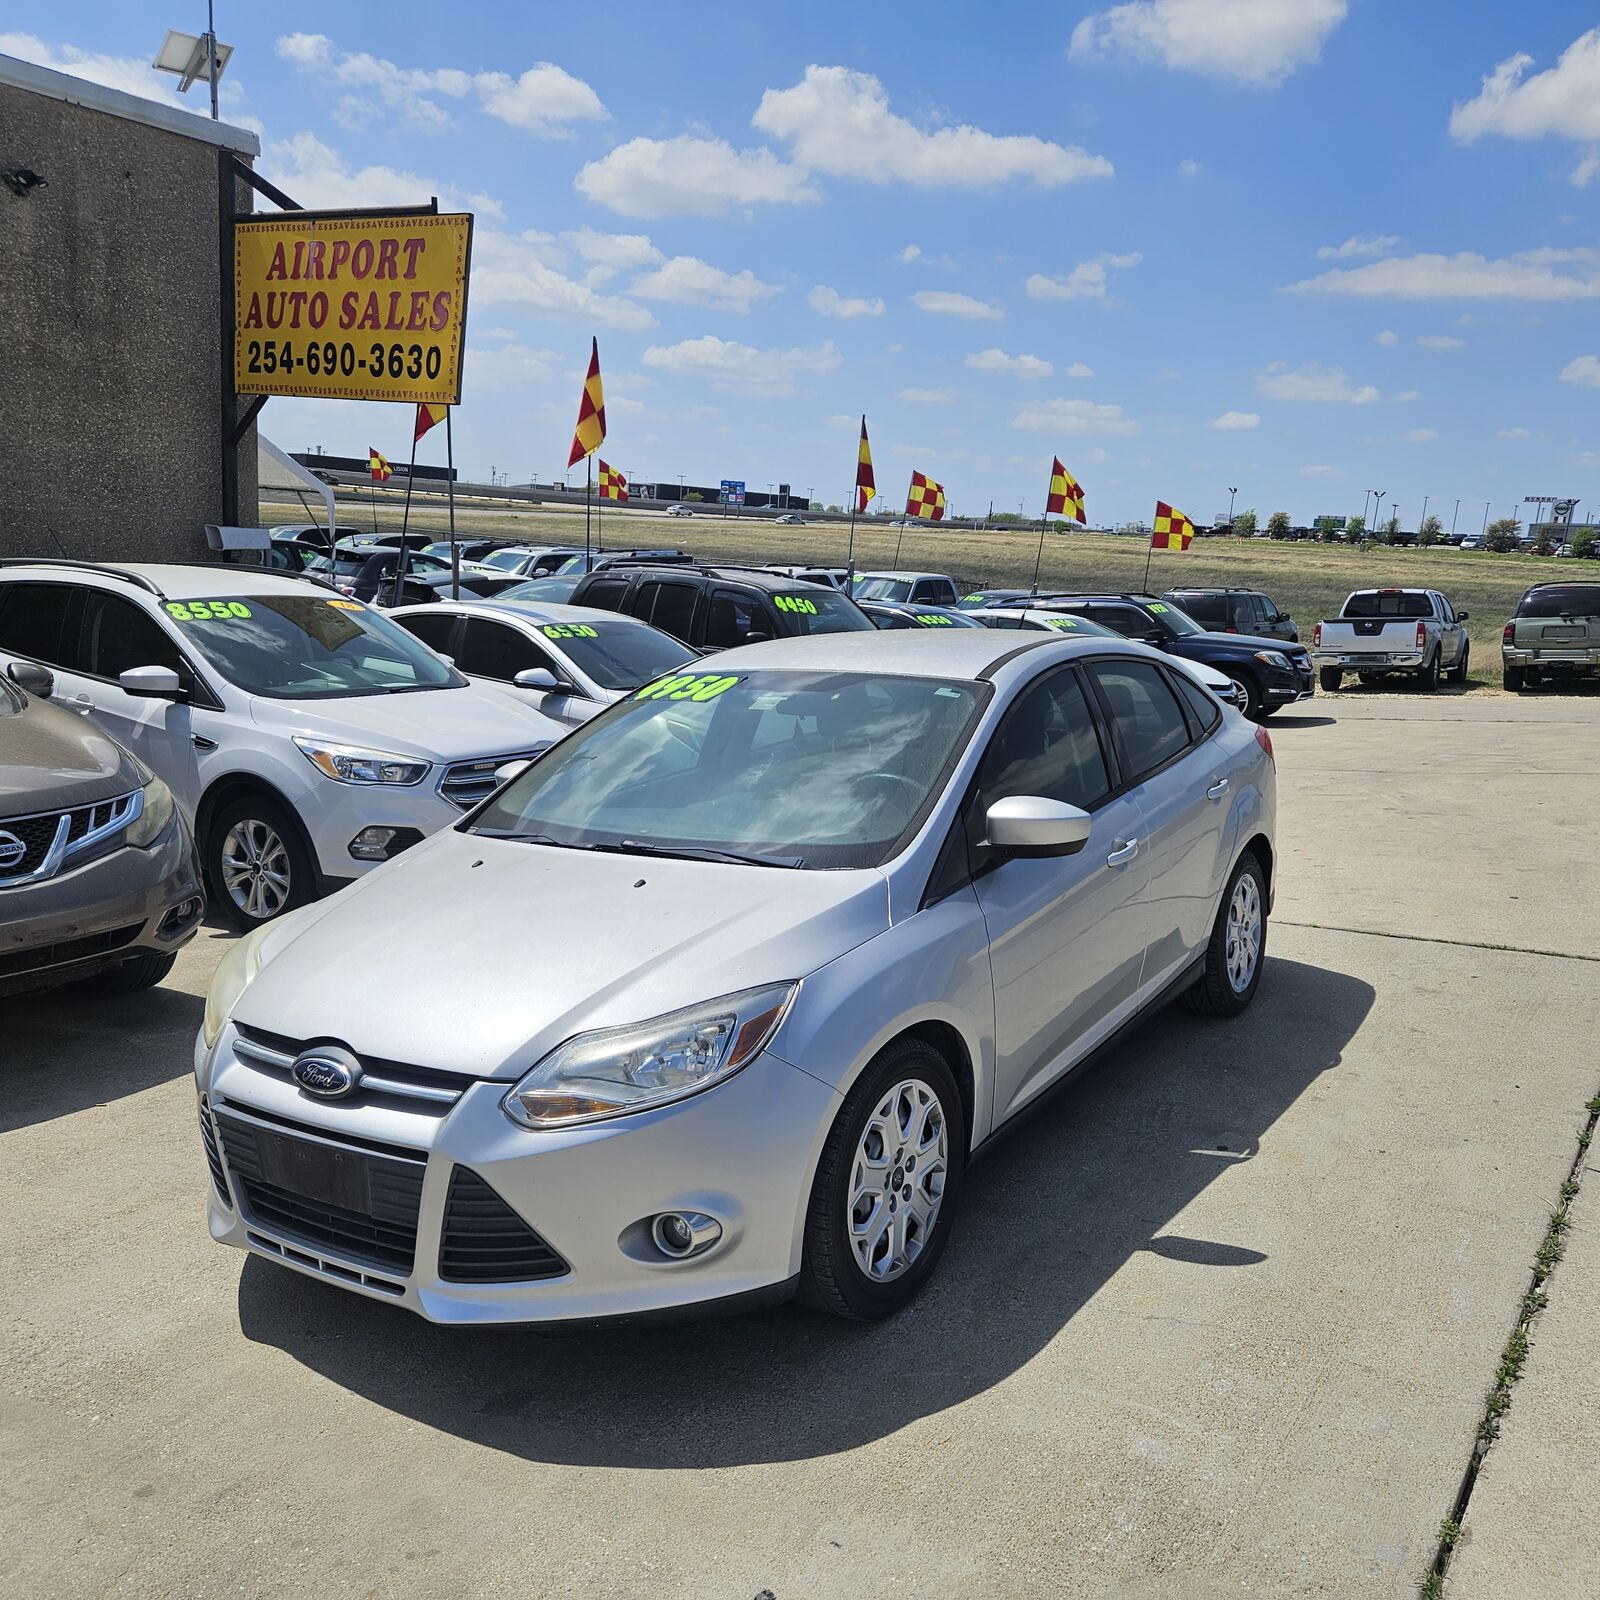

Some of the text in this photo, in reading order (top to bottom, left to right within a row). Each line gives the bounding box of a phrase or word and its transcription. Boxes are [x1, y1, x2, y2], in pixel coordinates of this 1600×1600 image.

[265, 238, 426, 281] AIRPORT
[243, 290, 452, 332] AUTO SALES
[248, 340, 442, 380] 254-690-3630
[164, 600, 252, 622] 8550
[543, 624, 599, 639] 6550
[301, 1062, 340, 1087] Ford
